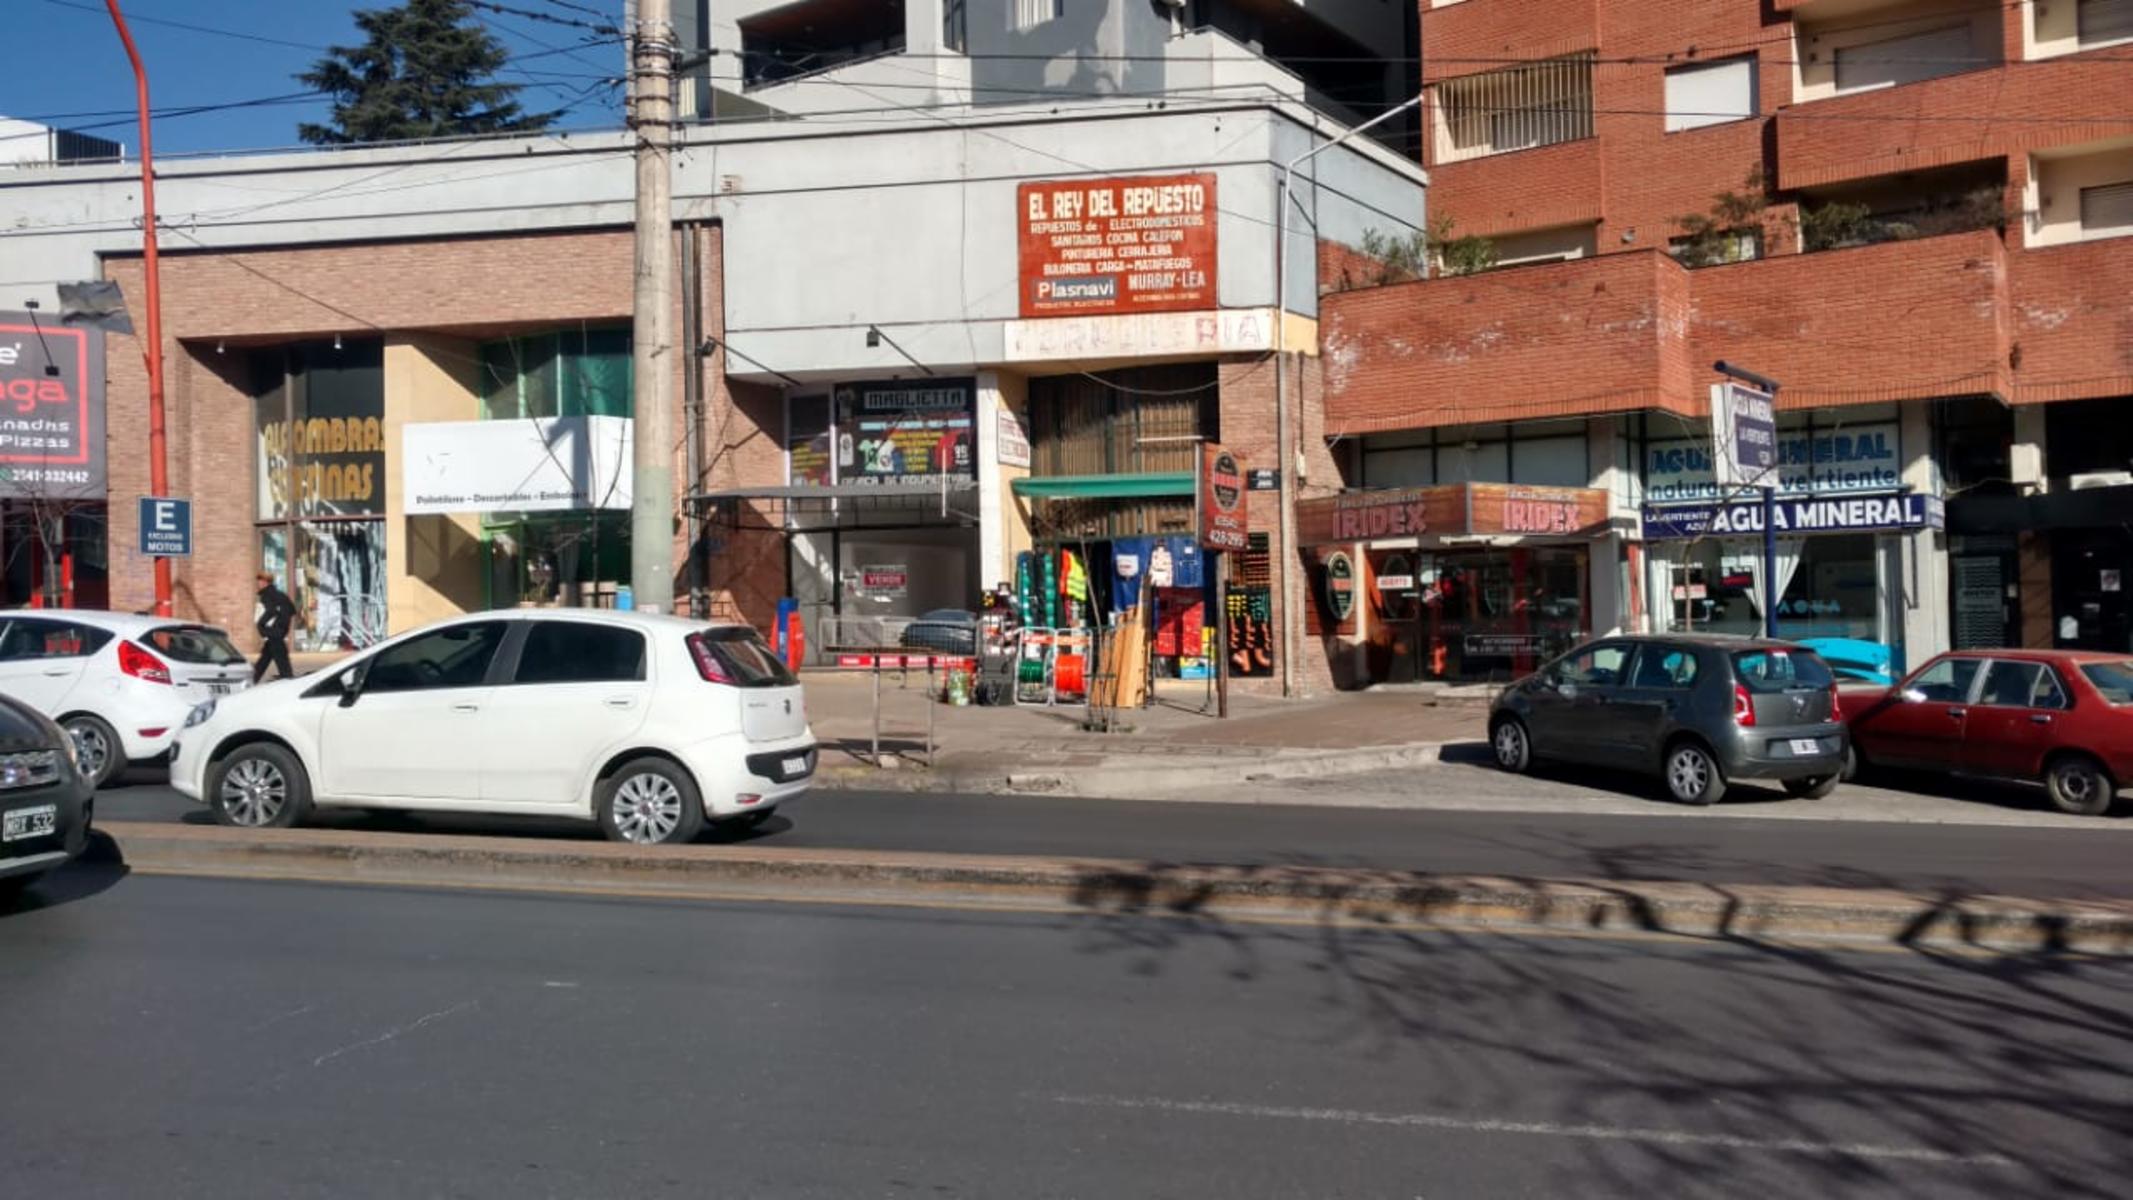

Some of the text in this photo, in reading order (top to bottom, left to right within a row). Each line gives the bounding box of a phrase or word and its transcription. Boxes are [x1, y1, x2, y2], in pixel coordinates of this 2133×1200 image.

[1029, 185, 1204, 220] EL REY DEL REPUESTO
[1031, 221, 1081, 233] REPUESTOS
[1106, 233, 1138, 245] COCINA
[1142, 230, 1183, 243] CALEFON
[1118, 245, 1172, 258] CERRAJERIA
[1037, 279, 1115, 299] Plasnavi
[264, 416, 385, 456] ALFOMBRA
[1777, 432, 1893, 465] INERAL
[156, 501, 176, 530] E
[1333, 503, 1427, 539] IRIDEX
[1503, 499, 1581, 532] IRIDEX
[1713, 505, 1789, 532] AGUA
[1795, 498, 1922, 528] MINERAL
[148, 542, 183, 552] MOTOS
